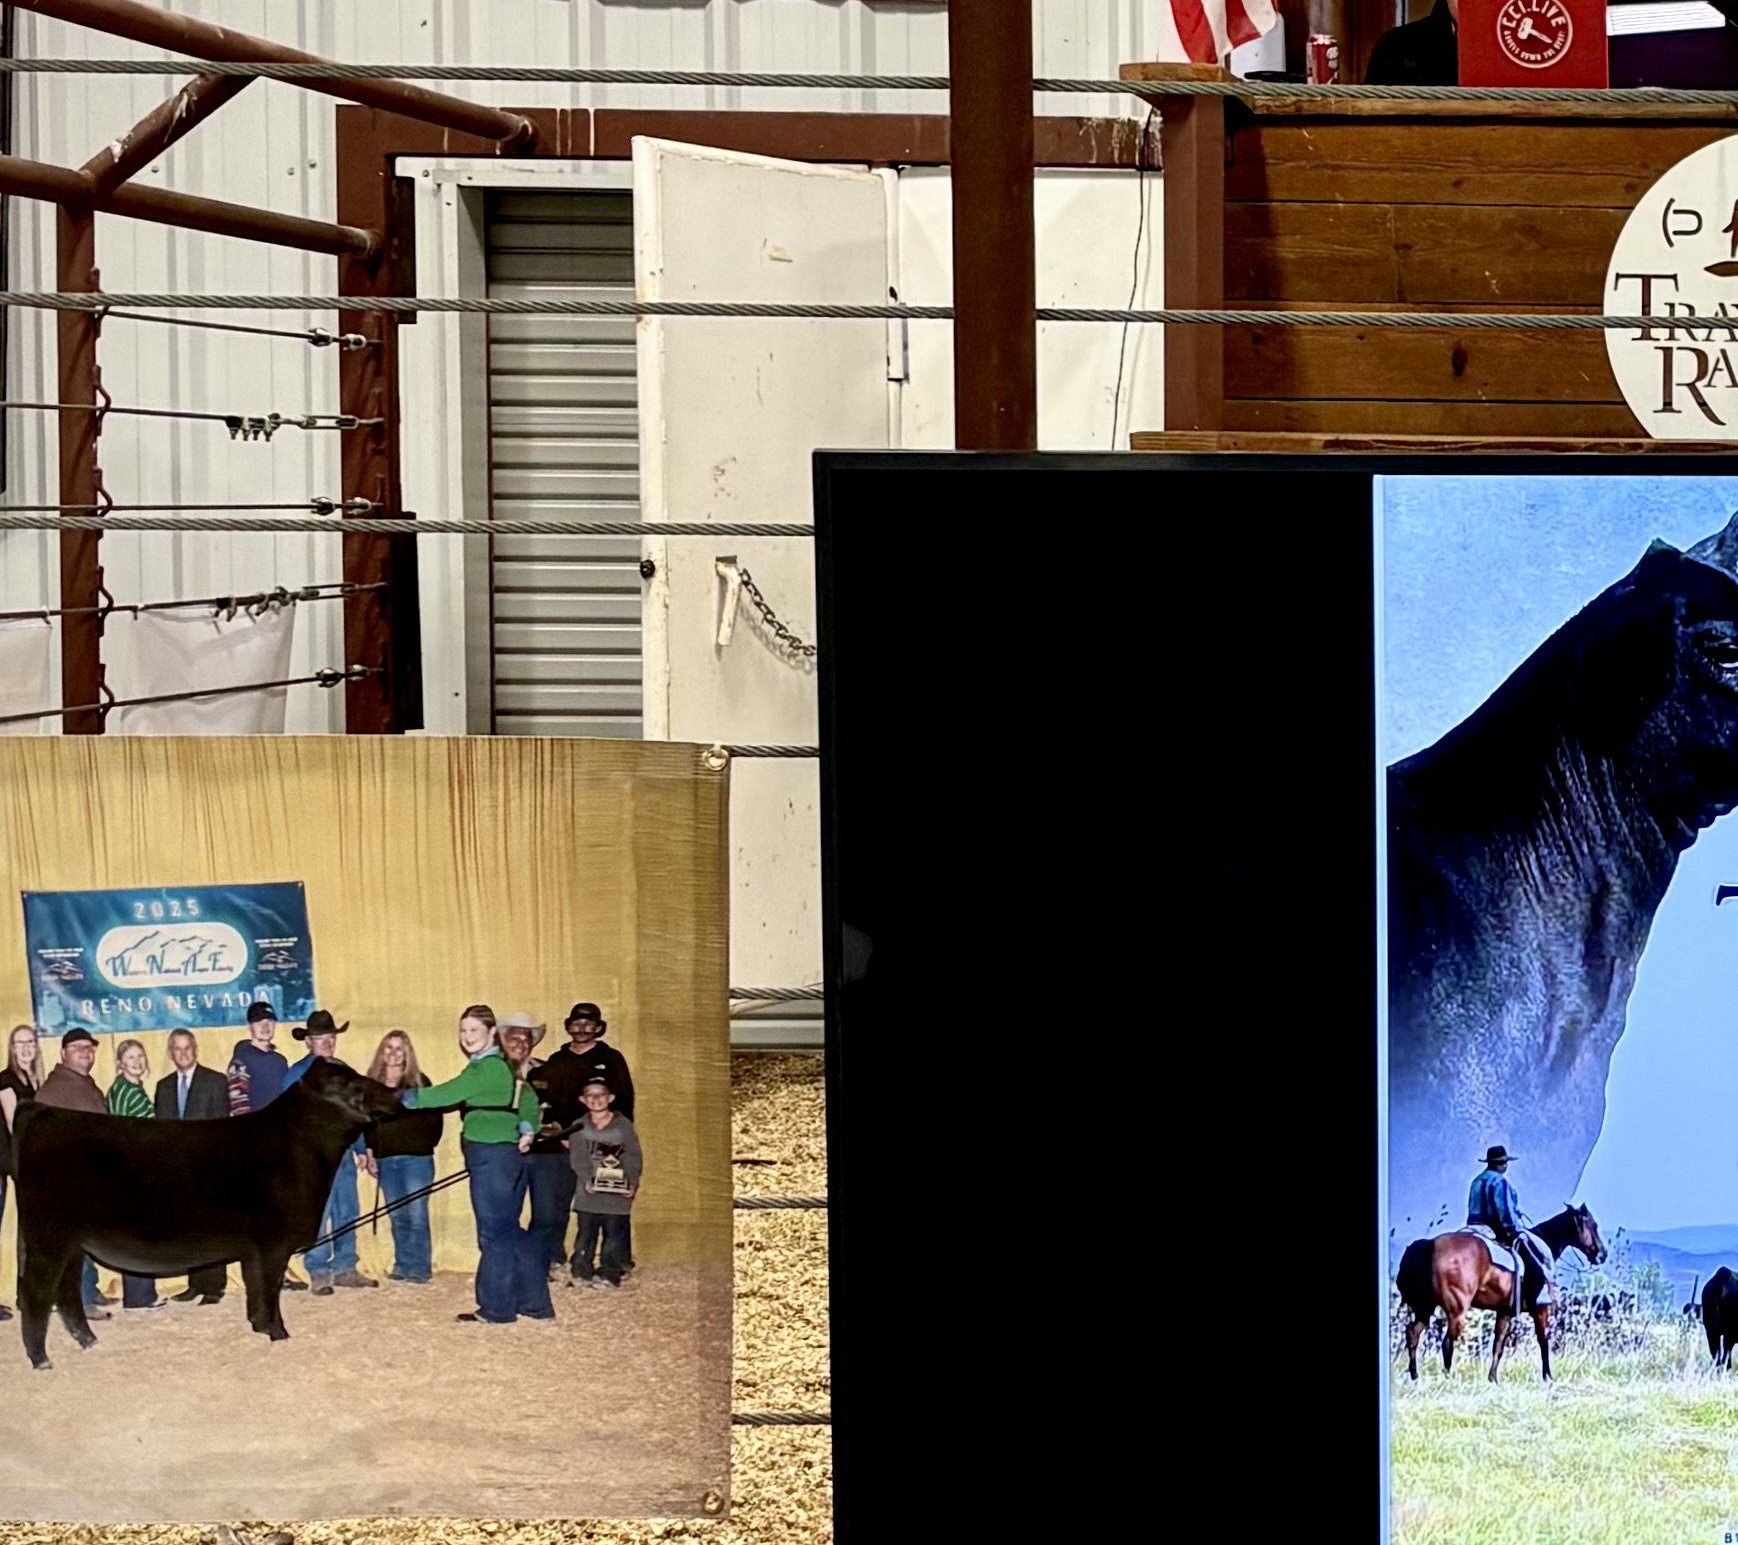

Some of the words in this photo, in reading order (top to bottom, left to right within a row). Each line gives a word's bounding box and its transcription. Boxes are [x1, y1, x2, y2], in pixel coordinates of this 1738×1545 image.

[134, 899, 200, 919] 2025
[81, 998, 153, 1019] RENO
[167, 990, 271, 1011] NEVADA
